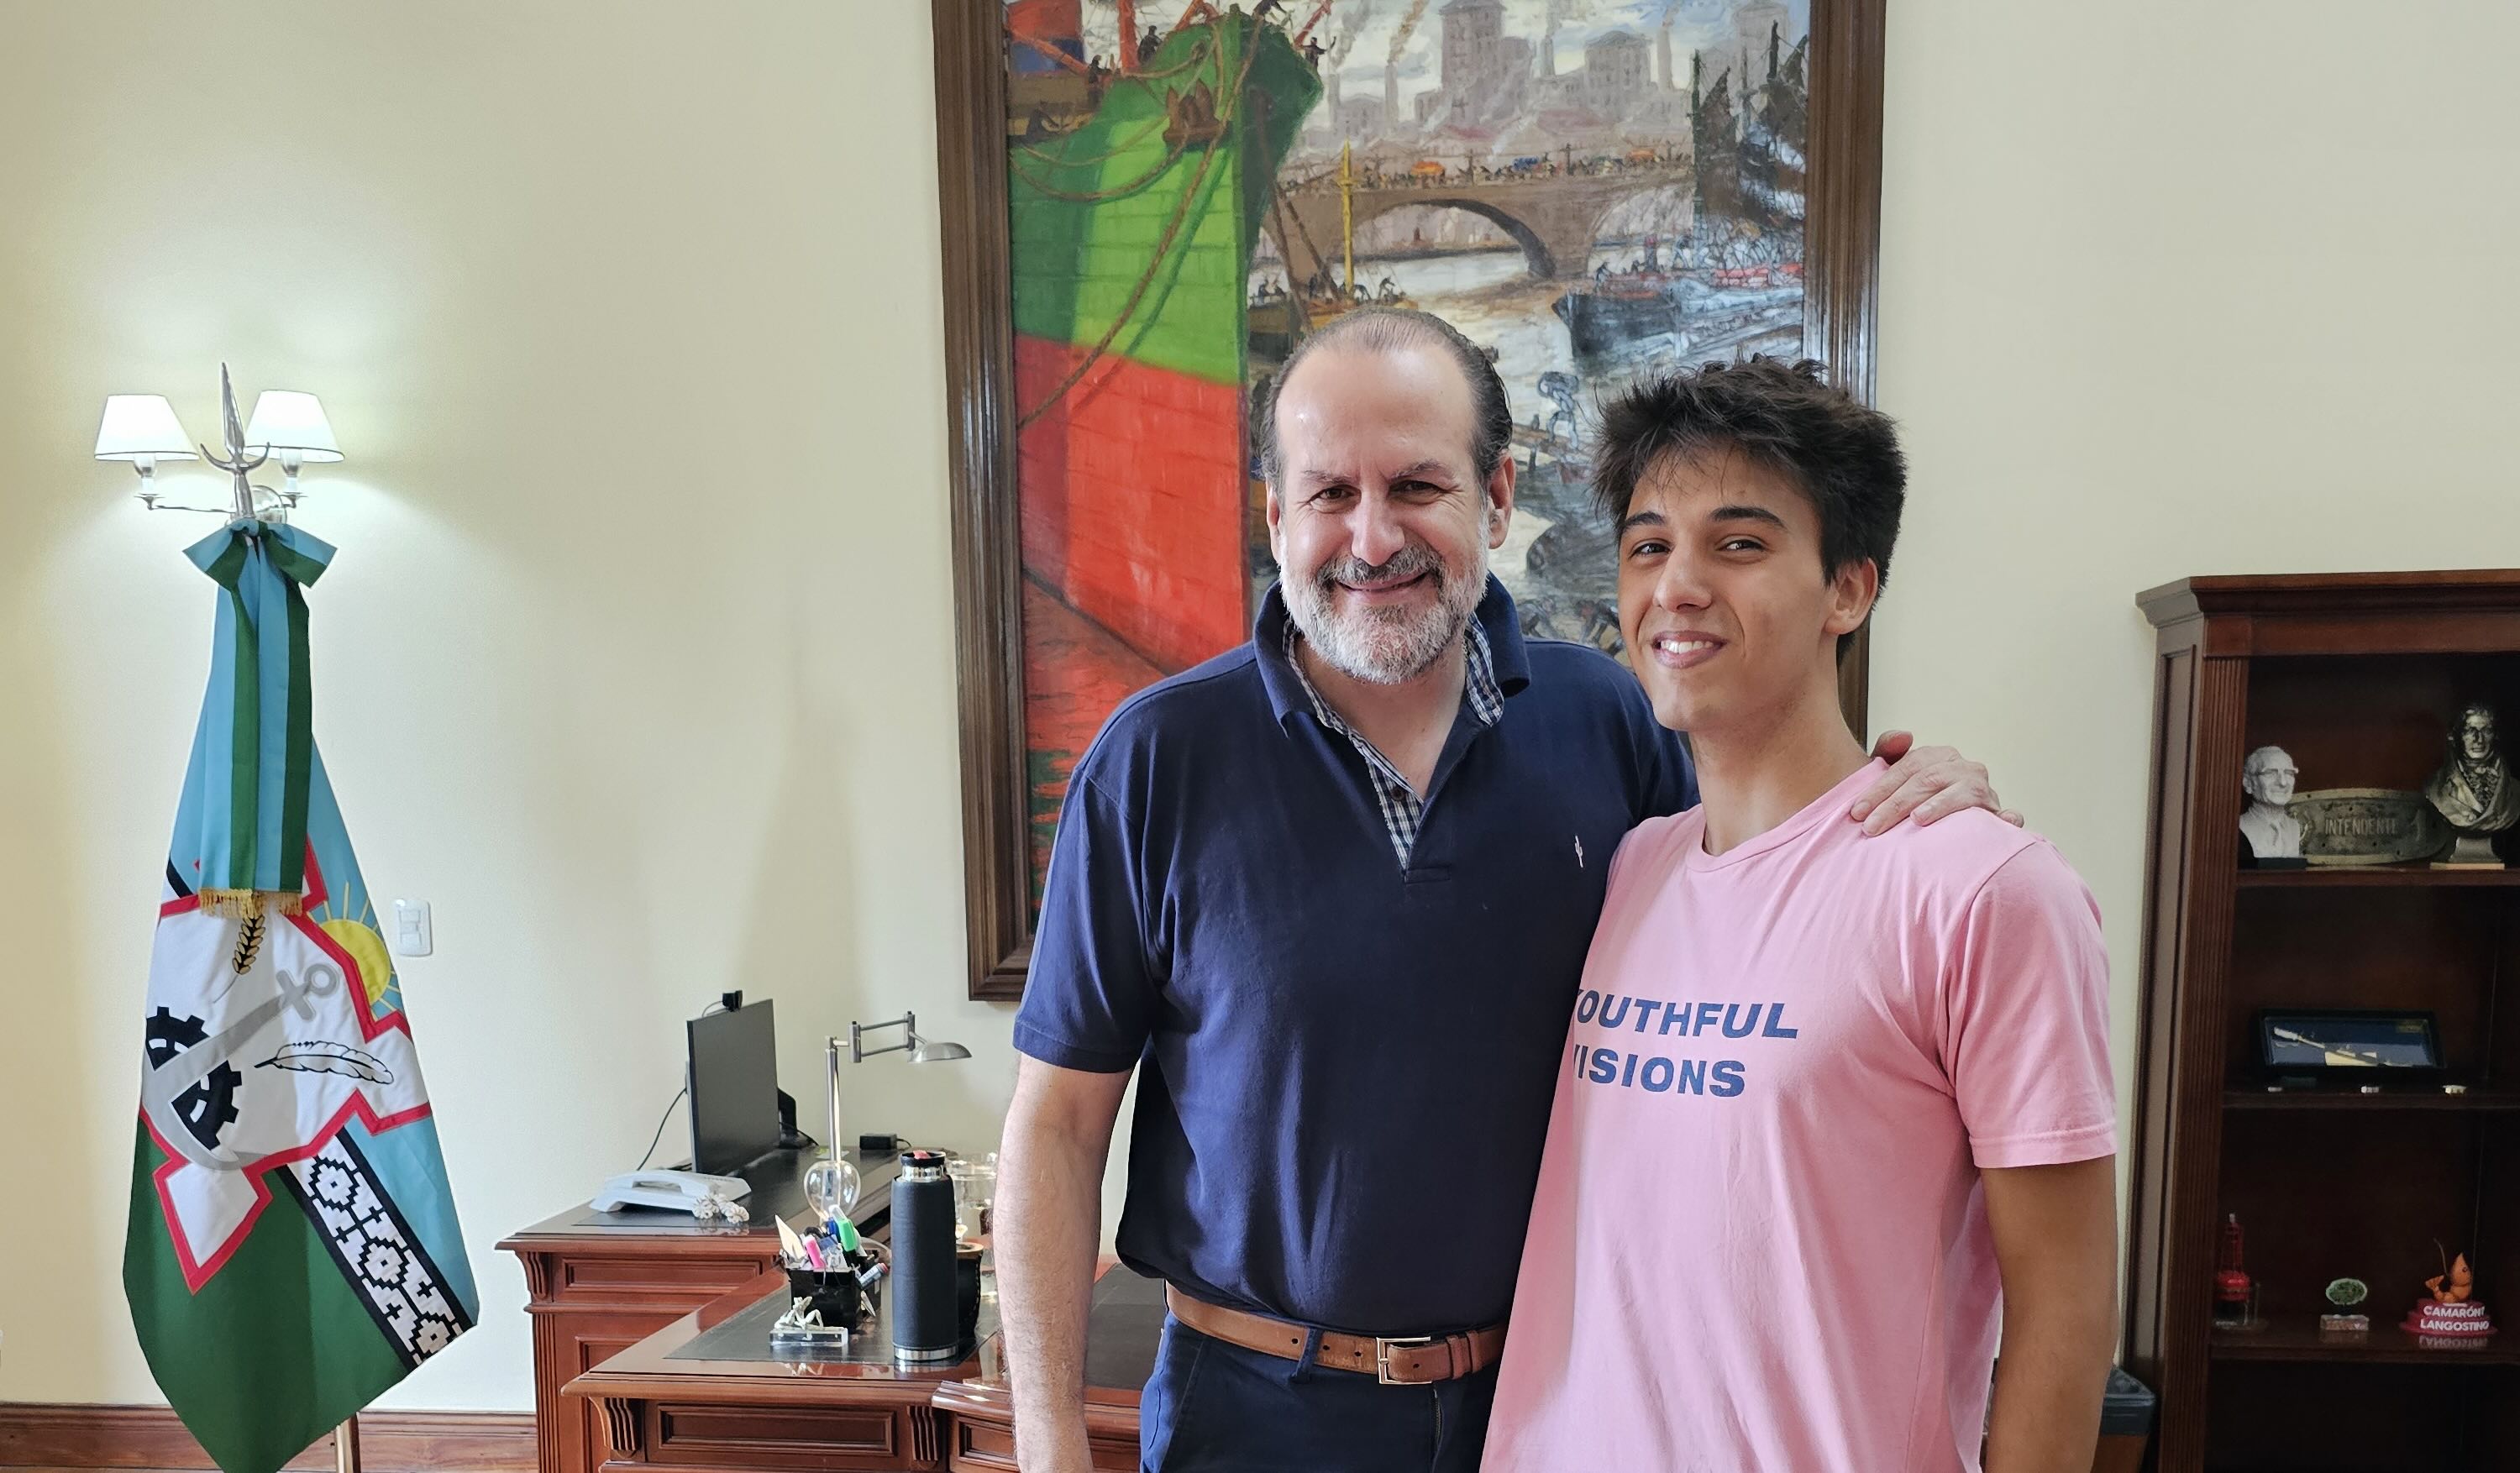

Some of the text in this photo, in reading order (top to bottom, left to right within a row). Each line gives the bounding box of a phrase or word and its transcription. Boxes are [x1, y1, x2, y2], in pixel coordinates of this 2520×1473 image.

[2324, 818, 2397, 835] INTENDENTE
[1577, 988, 1798, 1039] OUTHFUL
[2420, 1318, 2490, 1331] LANGOSTINO
